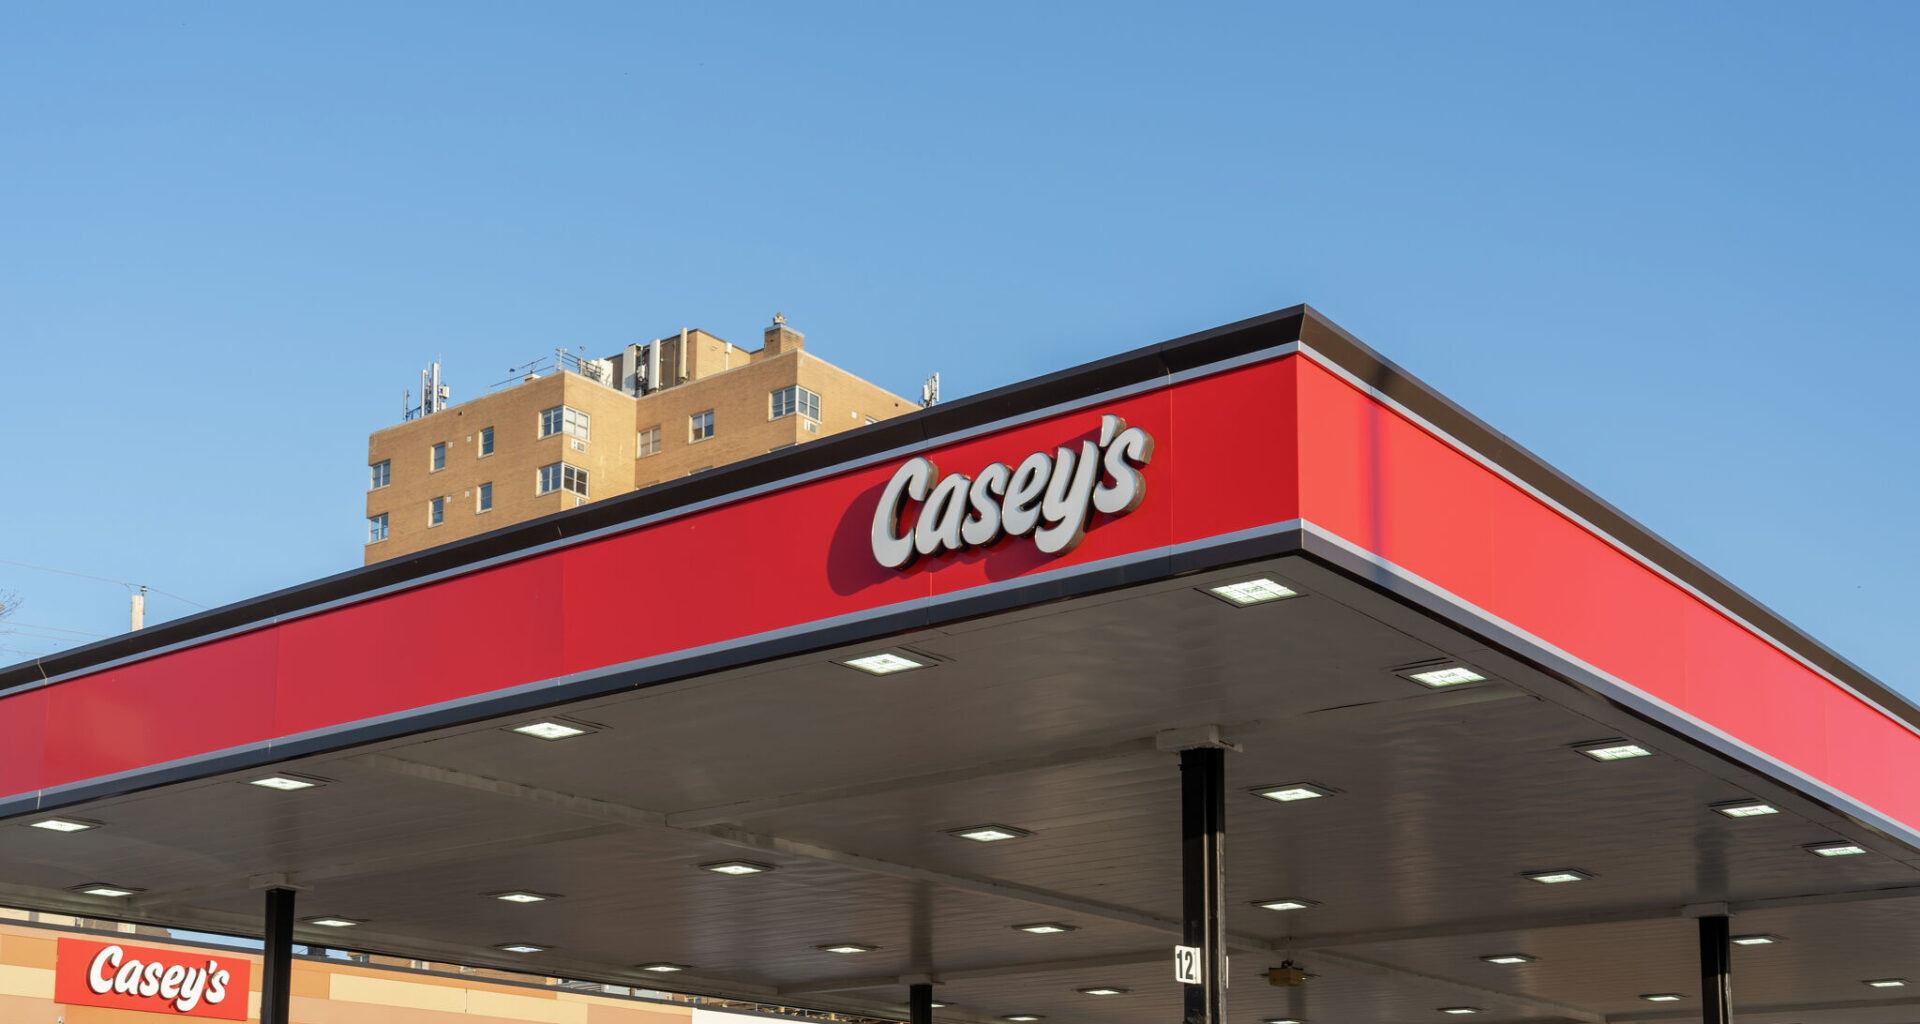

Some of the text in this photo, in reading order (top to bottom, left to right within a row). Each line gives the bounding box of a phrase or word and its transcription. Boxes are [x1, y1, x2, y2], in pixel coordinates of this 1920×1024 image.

[871, 414, 1153, 568] Casey's
[88, 945, 230, 1012] Casey's
[1176, 949, 1194, 980] 12
